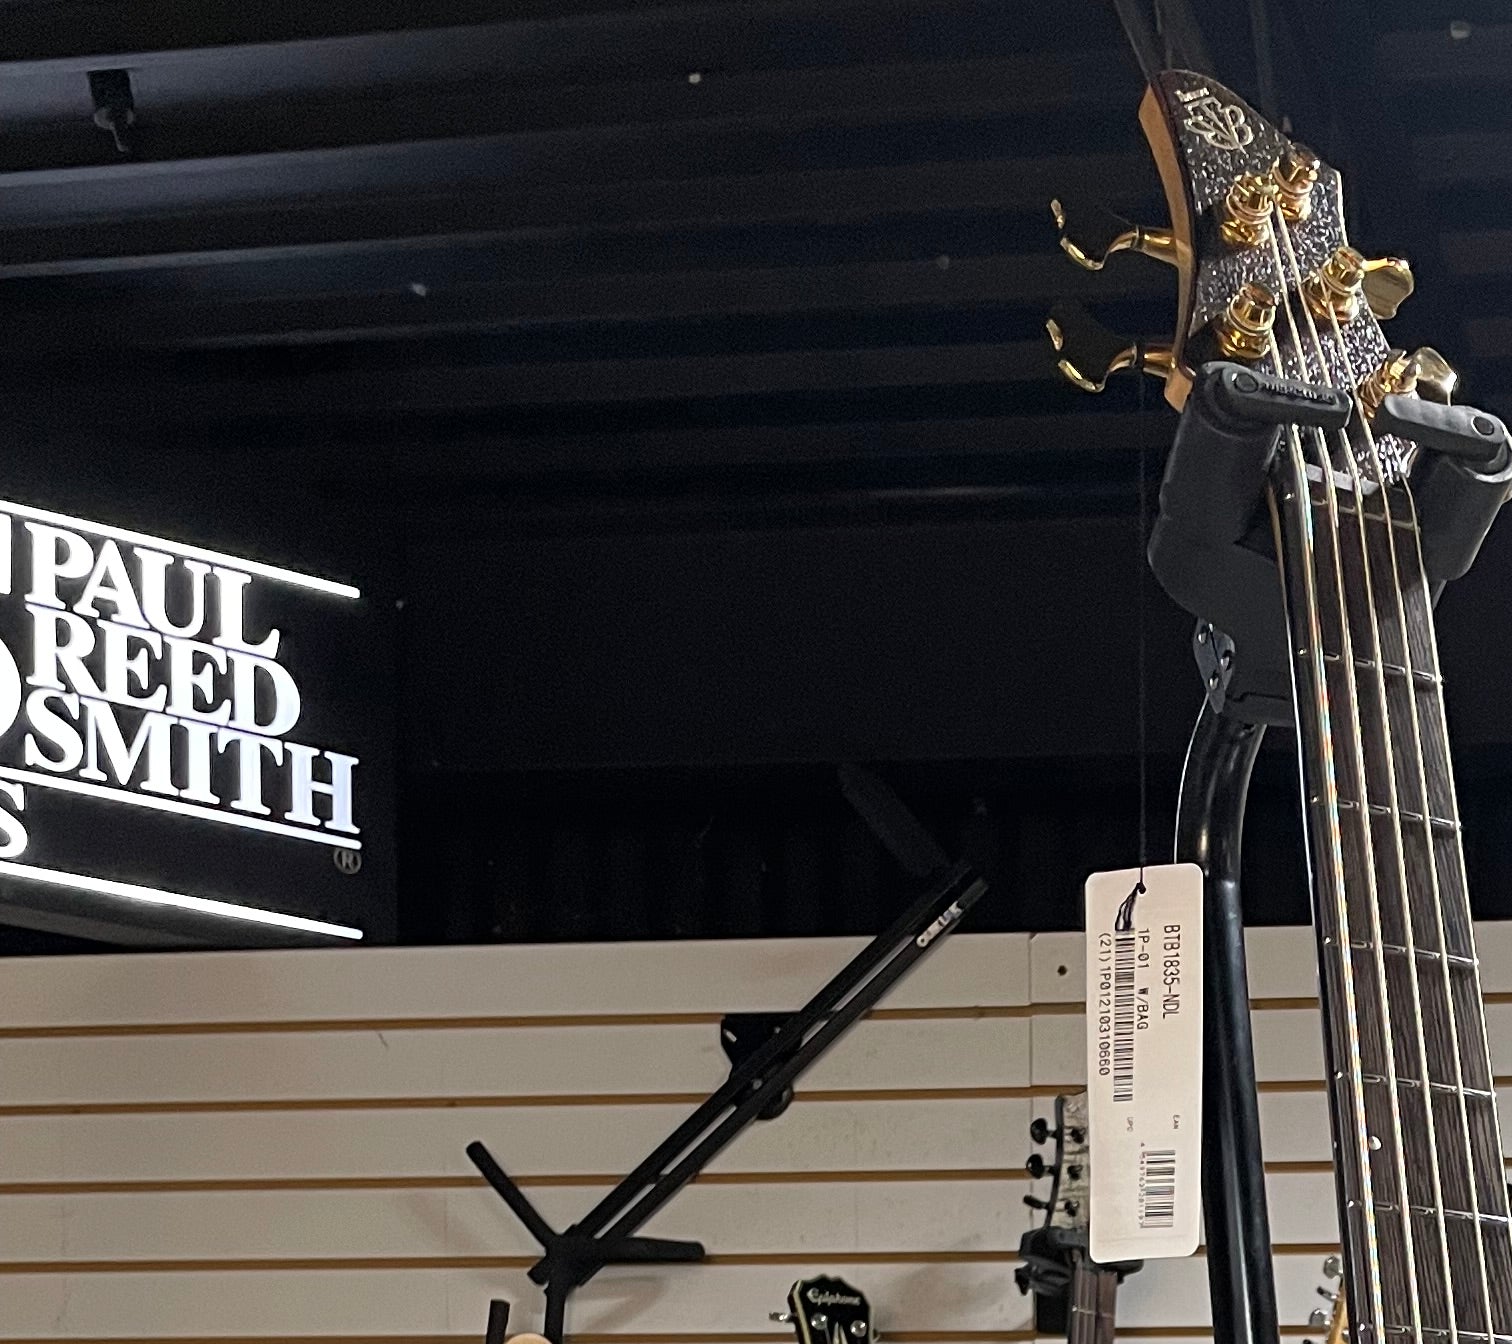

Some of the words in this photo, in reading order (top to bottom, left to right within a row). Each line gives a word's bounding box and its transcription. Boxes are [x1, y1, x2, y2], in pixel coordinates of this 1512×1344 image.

[24, 521, 280, 659] PAUL
[26, 602, 301, 737] REED
[24, 687, 360, 835] SMITH
[1137, 928, 1150, 969] 1P-01
[1163, 924, 1181, 1020] BTB1835-NDL
[1136, 987, 1149, 1030] W/BAG
